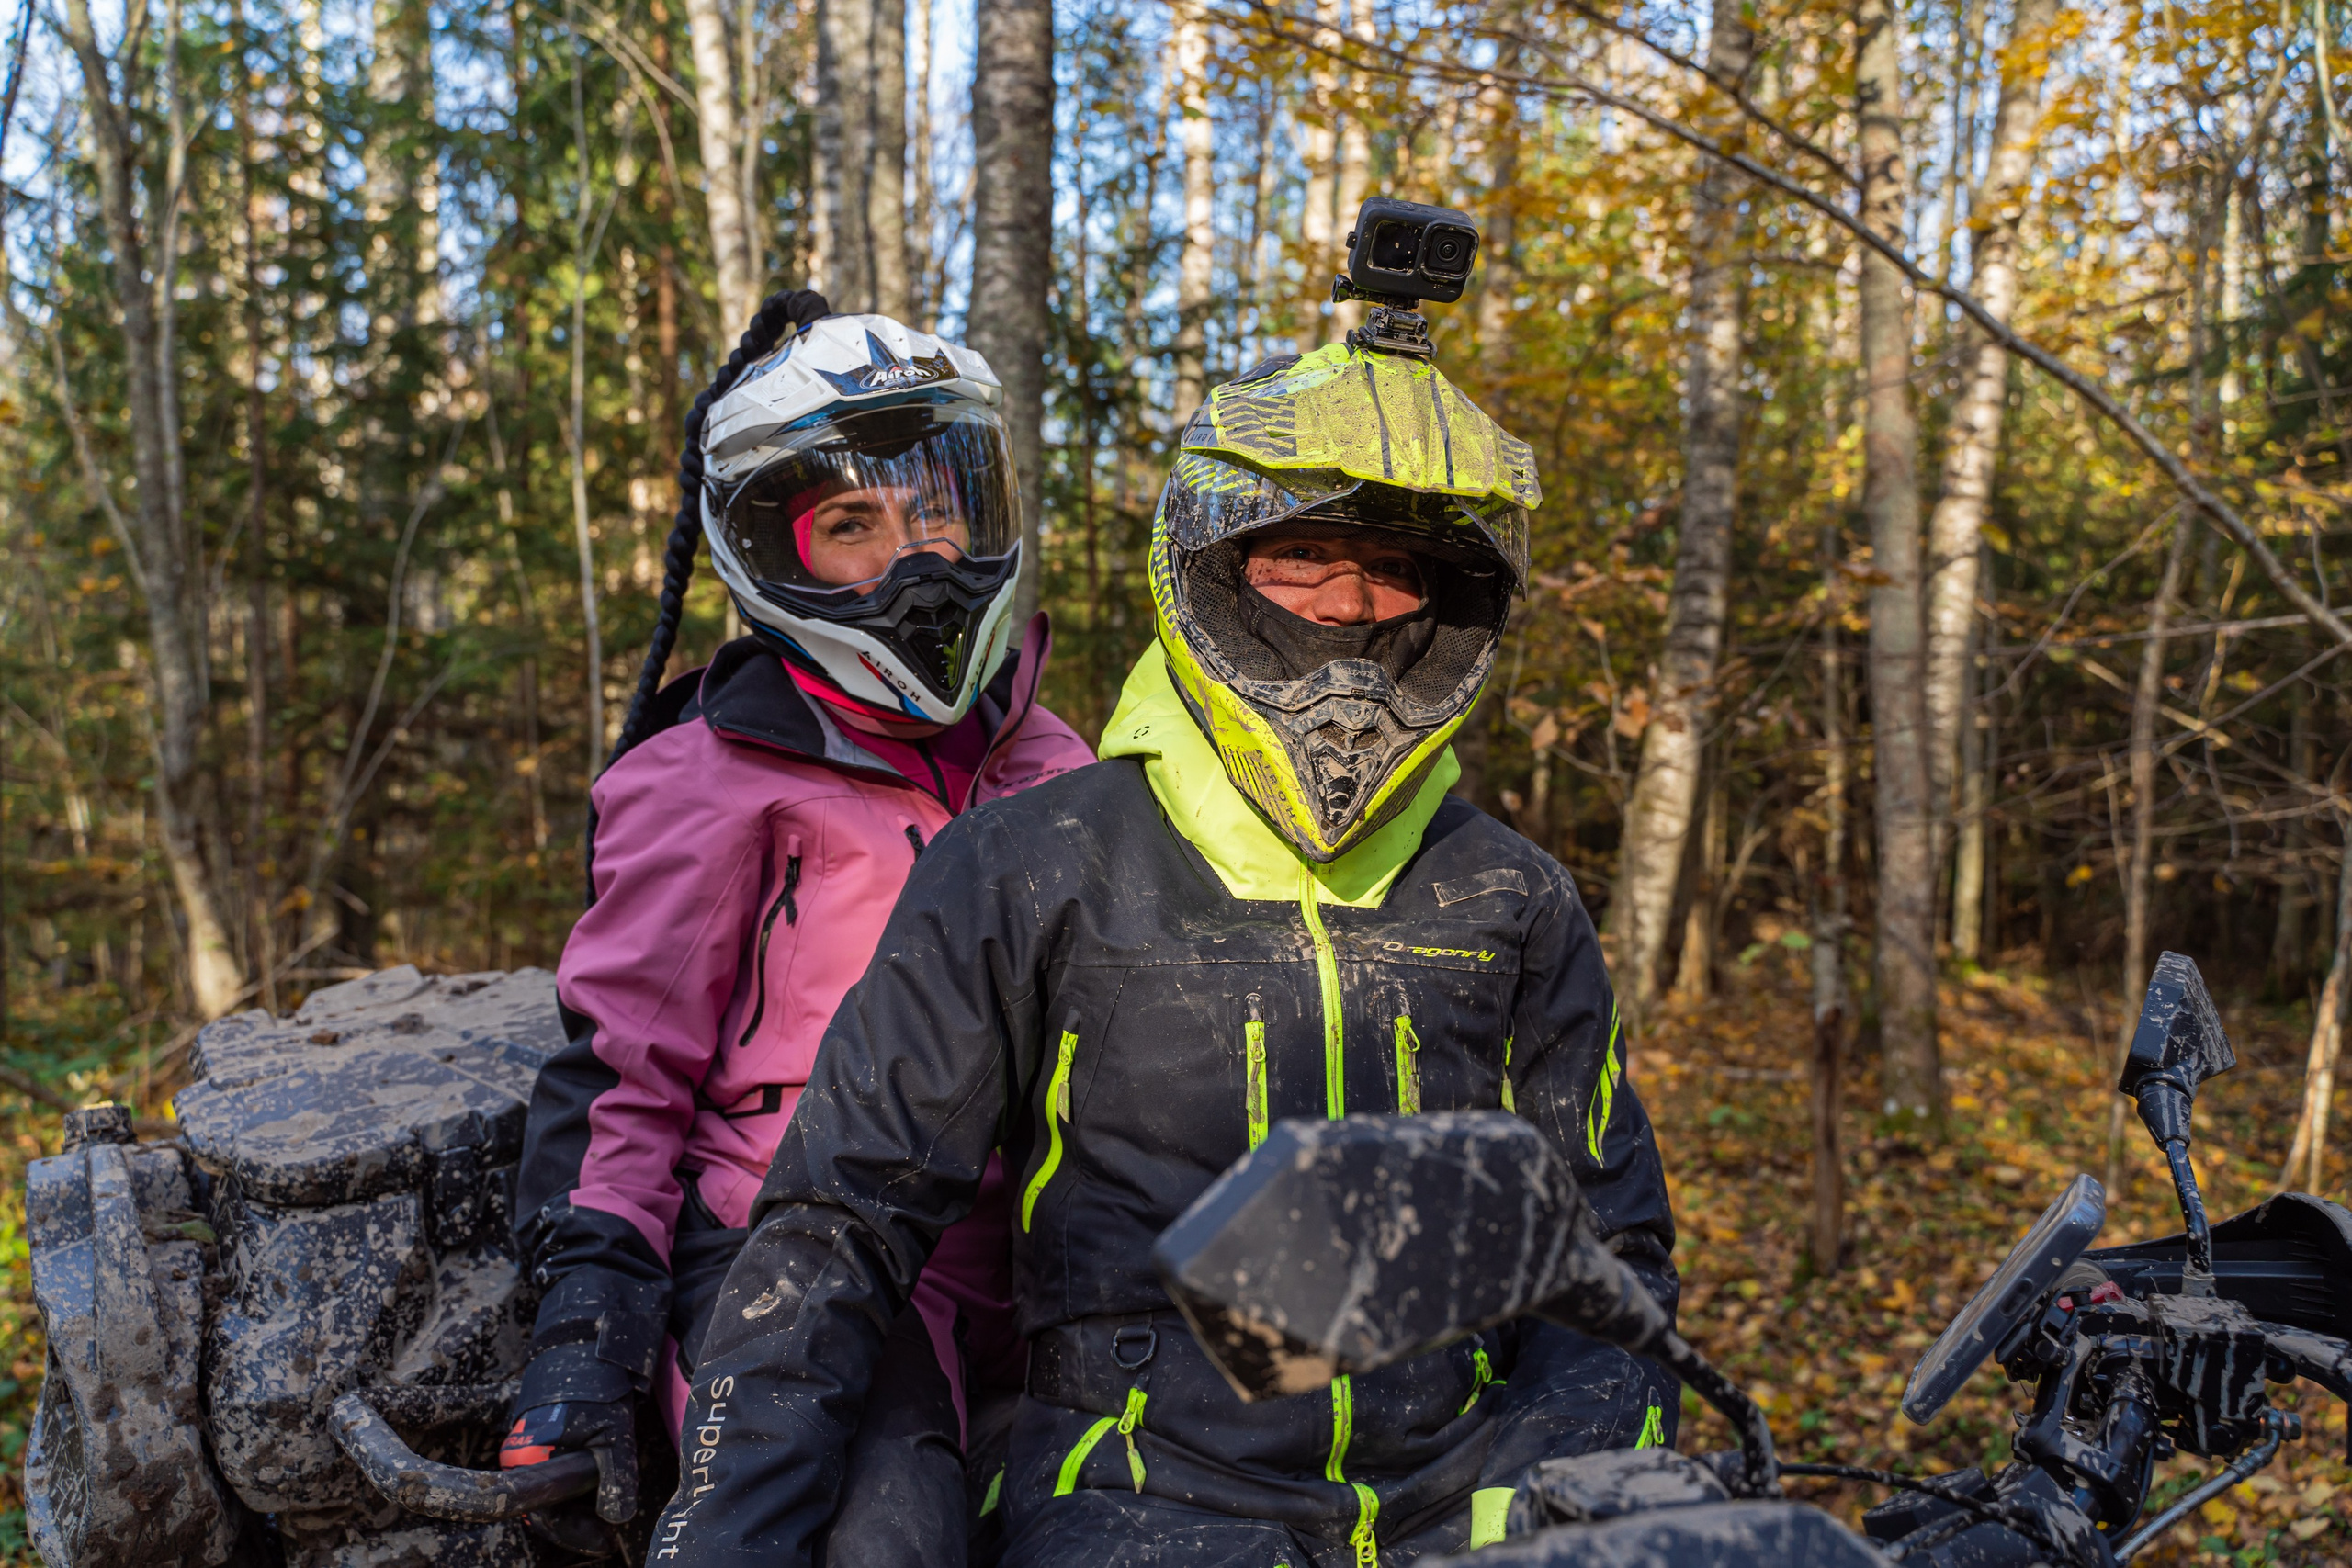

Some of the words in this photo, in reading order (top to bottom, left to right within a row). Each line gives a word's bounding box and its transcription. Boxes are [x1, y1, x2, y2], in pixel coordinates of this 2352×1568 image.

[861, 650, 921, 702] AIROH
[1382, 941, 1496, 962] Dragonfly
[657, 1375, 735, 1559] Superlht
